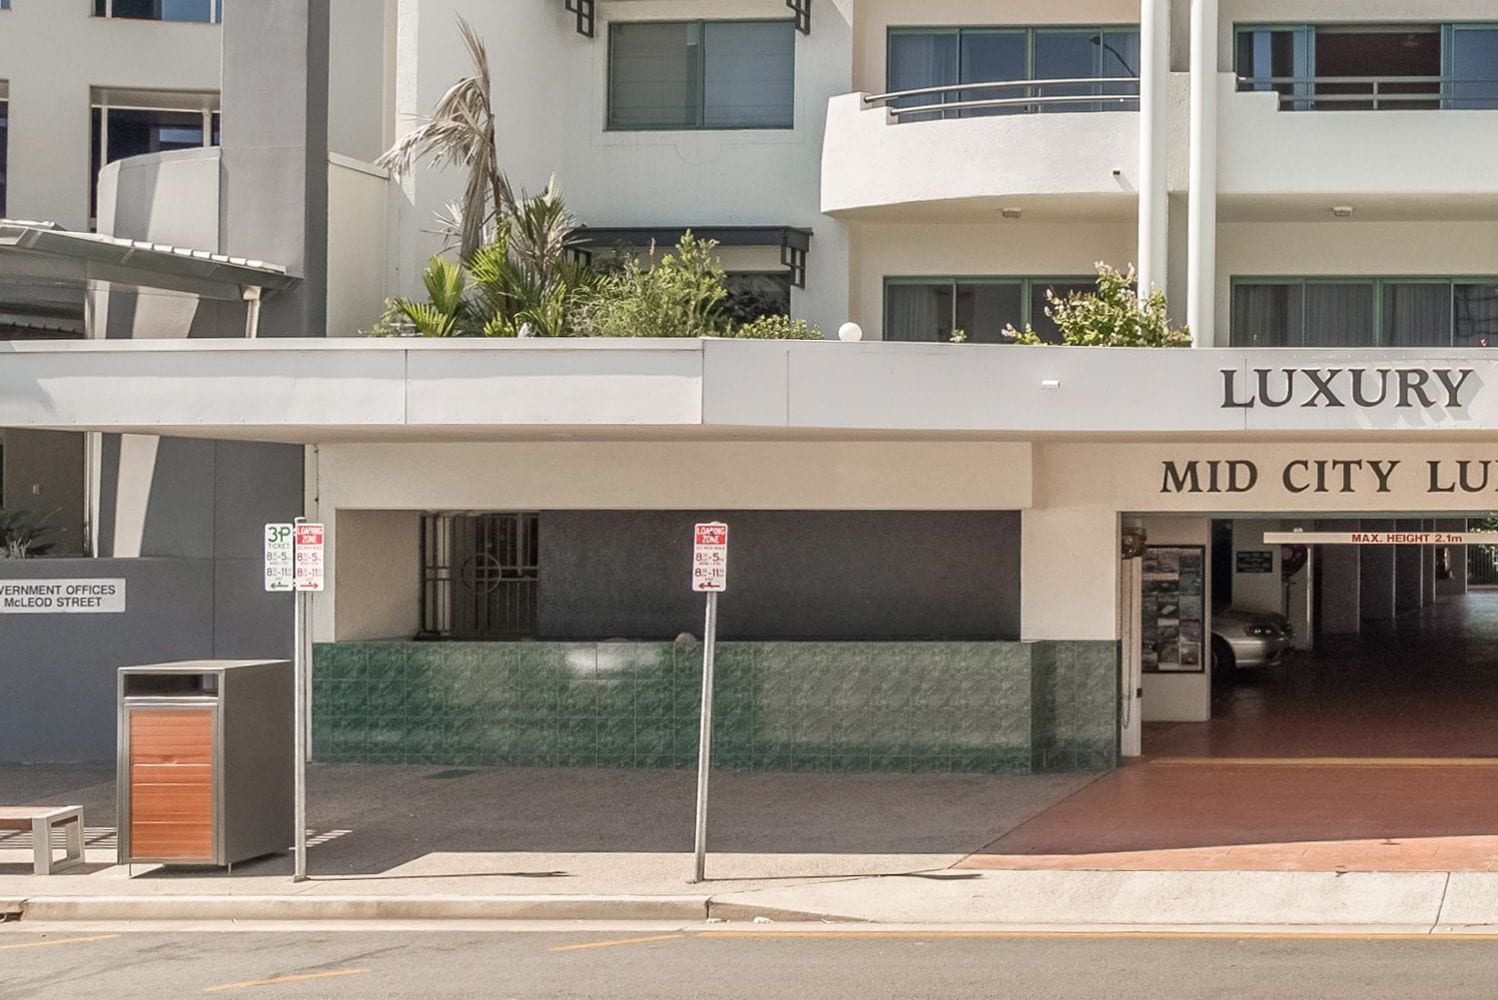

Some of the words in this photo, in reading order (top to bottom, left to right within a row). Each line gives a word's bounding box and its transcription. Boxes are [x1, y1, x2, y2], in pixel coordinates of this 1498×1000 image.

[1220, 368, 1474, 408] LUXURY
[1160, 459, 1258, 493] MID
[1282, 459, 1401, 493] CITY
[268, 526, 291, 542] 3P
[1351, 534, 1382, 542] MAX.
[1386, 534, 1430, 542] HEIGHT
[1435, 534, 1462, 542] 2.1m
[66, 585, 116, 595] OFFICES
[4, 597, 53, 607] McLEOD
[56, 597, 101, 607] STREET
